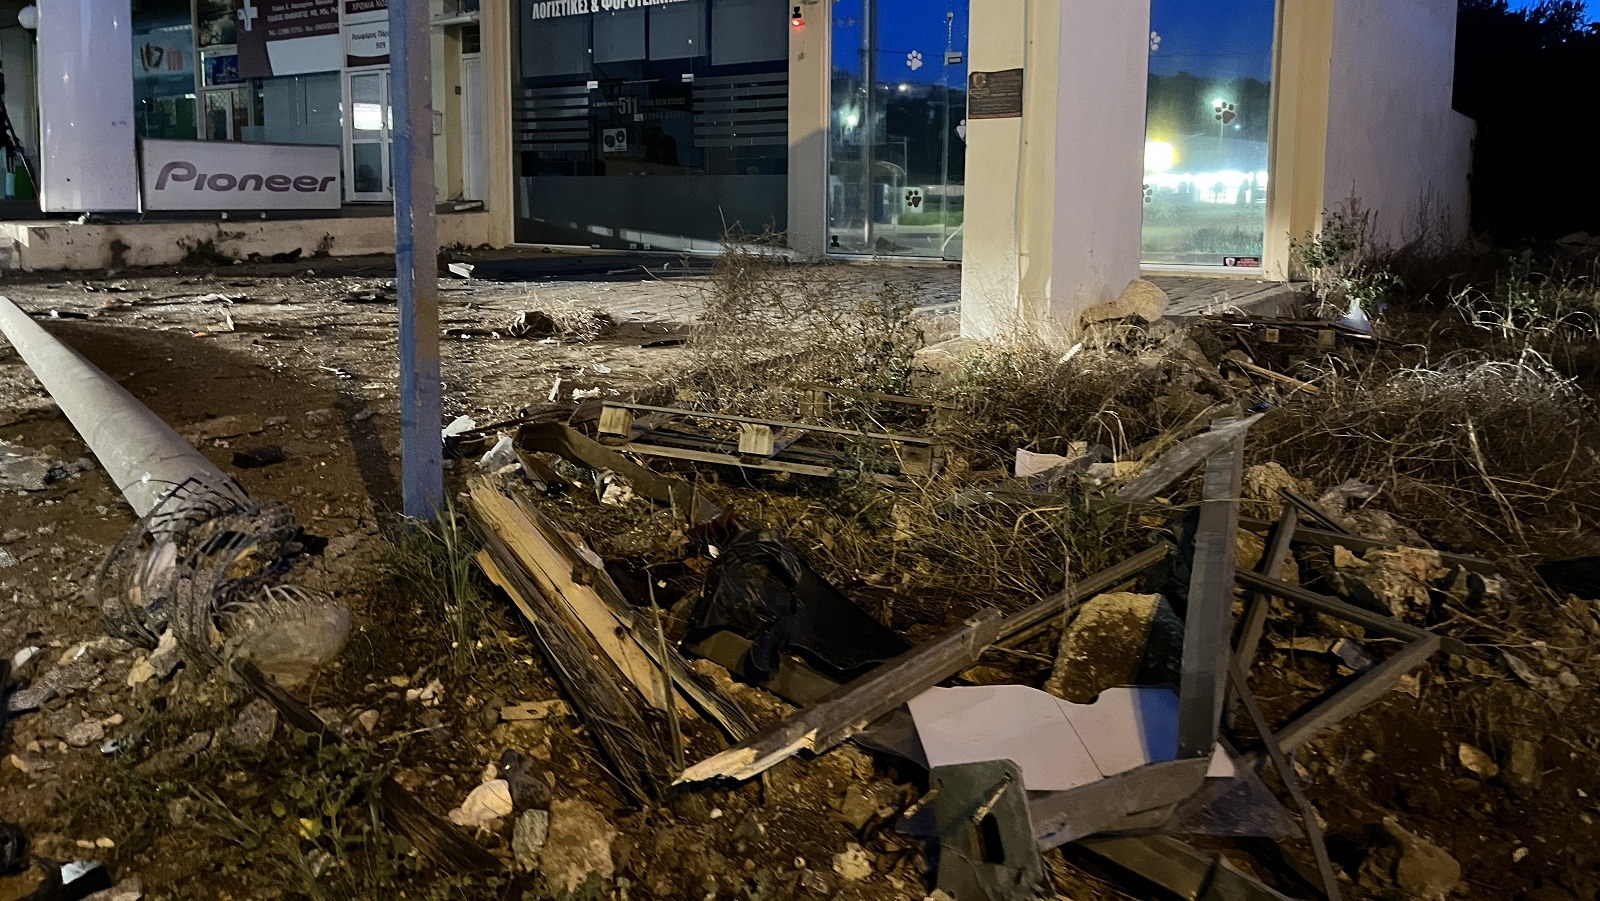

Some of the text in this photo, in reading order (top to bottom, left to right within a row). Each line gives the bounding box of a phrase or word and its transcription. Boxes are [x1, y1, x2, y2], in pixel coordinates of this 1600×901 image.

[591, 0, 600, 13] &
[619, 97, 637, 115] 511
[154, 161, 337, 193] Pioneer
